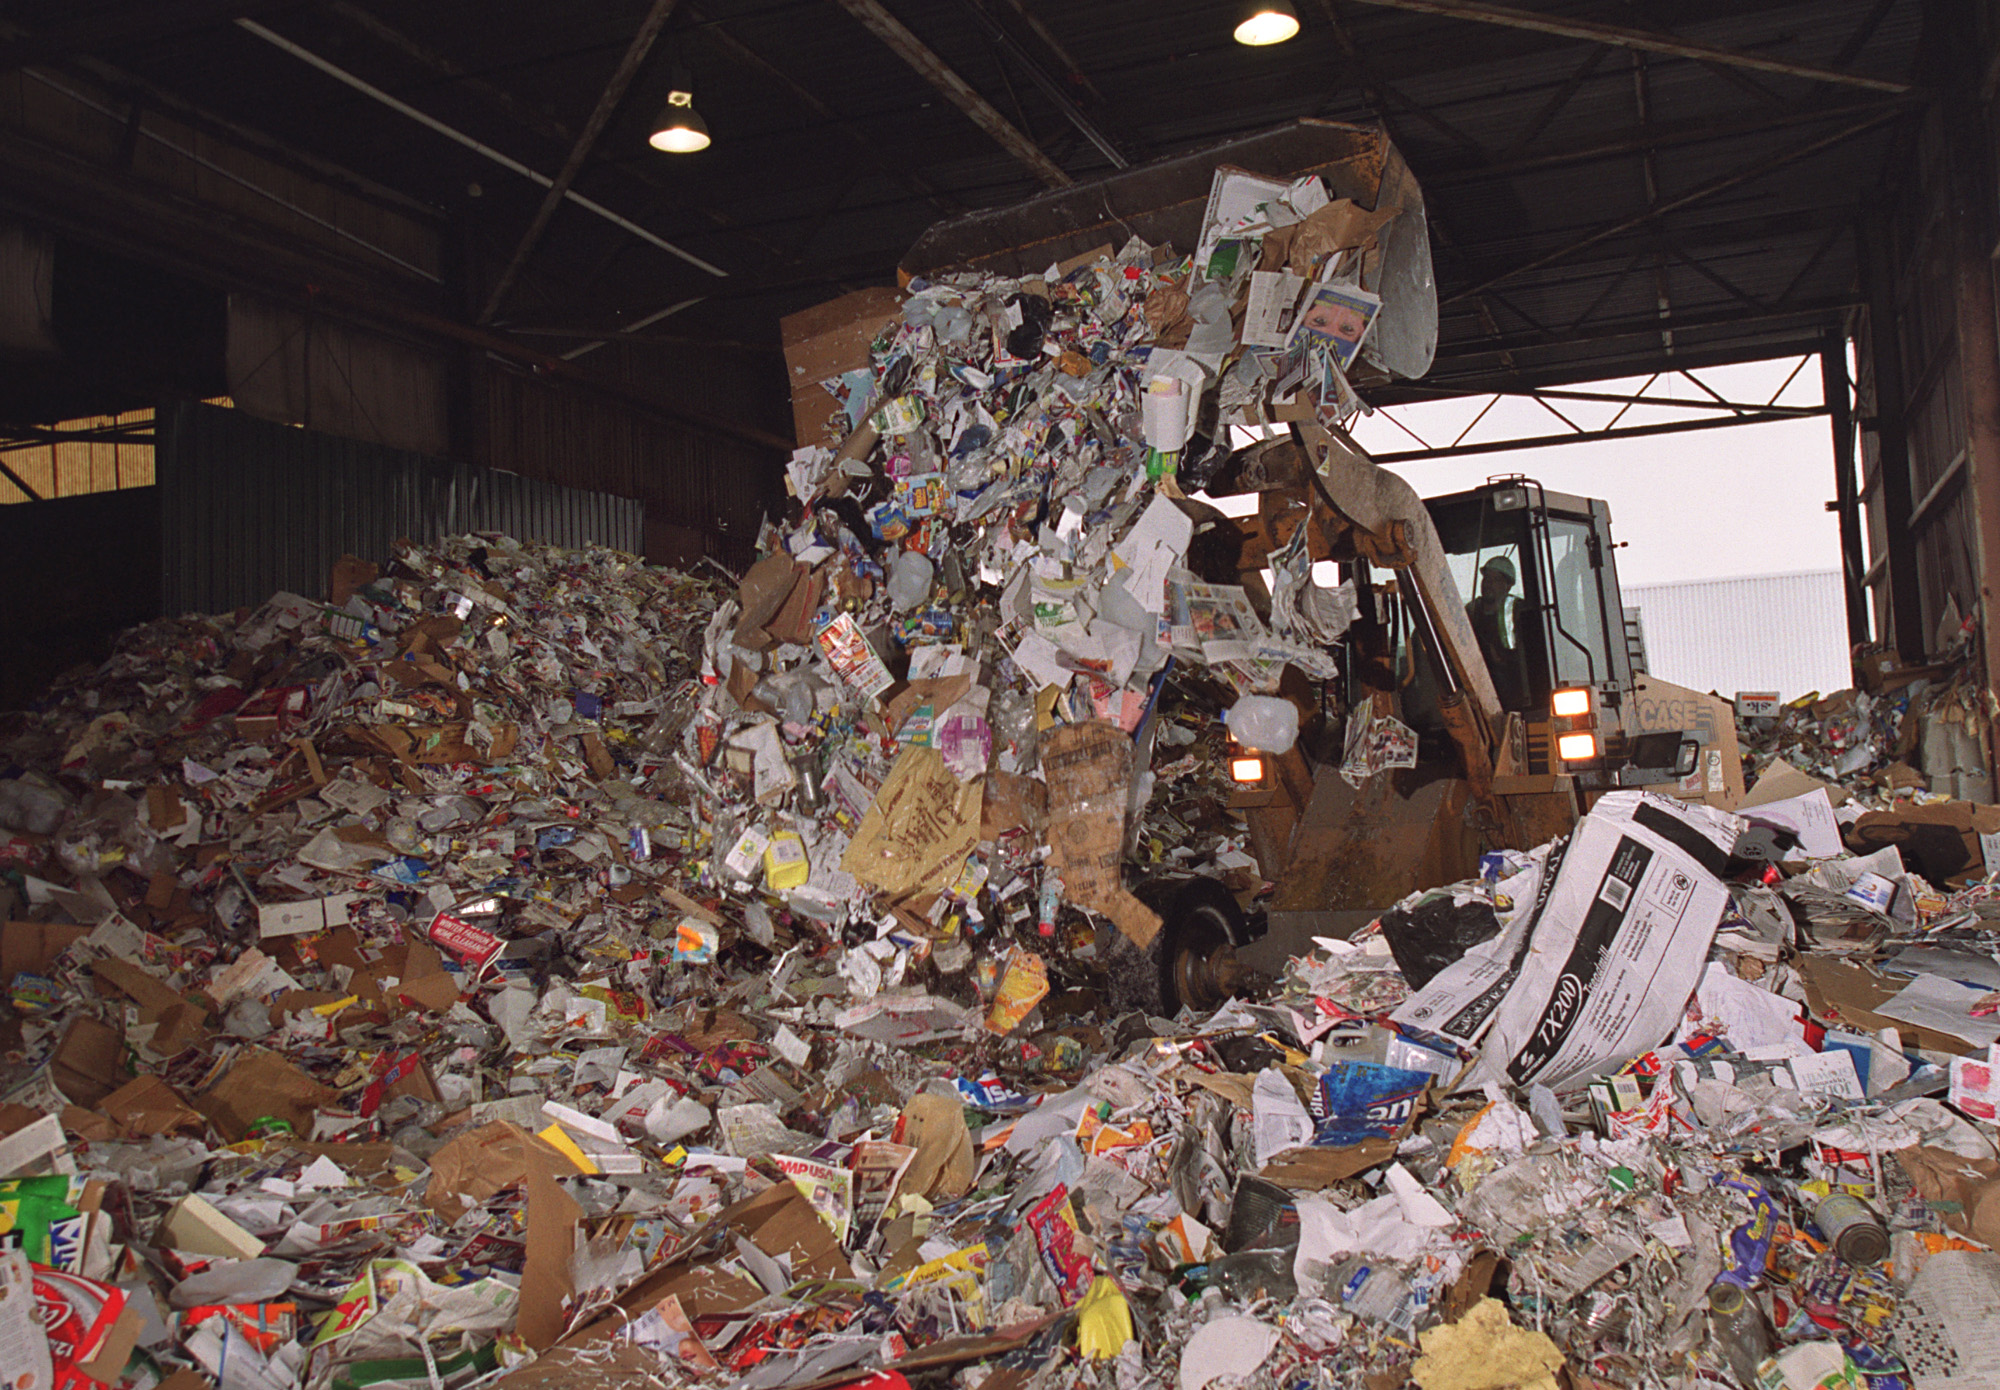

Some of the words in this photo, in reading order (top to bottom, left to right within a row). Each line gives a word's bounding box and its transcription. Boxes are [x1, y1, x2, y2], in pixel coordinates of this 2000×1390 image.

[1639, 699, 1697, 731] CASE
[434, 927, 454, 940] HOME
[452, 934, 488, 954] CLEARANCE
[438, 918, 465, 933] WINTER
[461, 928, 490, 945] FASHION
[1583, 944, 1610, 998] Treadmill
[1537, 979, 1578, 1047] TX200
[775, 1160, 809, 1175] OMP
[808, 1164, 834, 1182] USA
